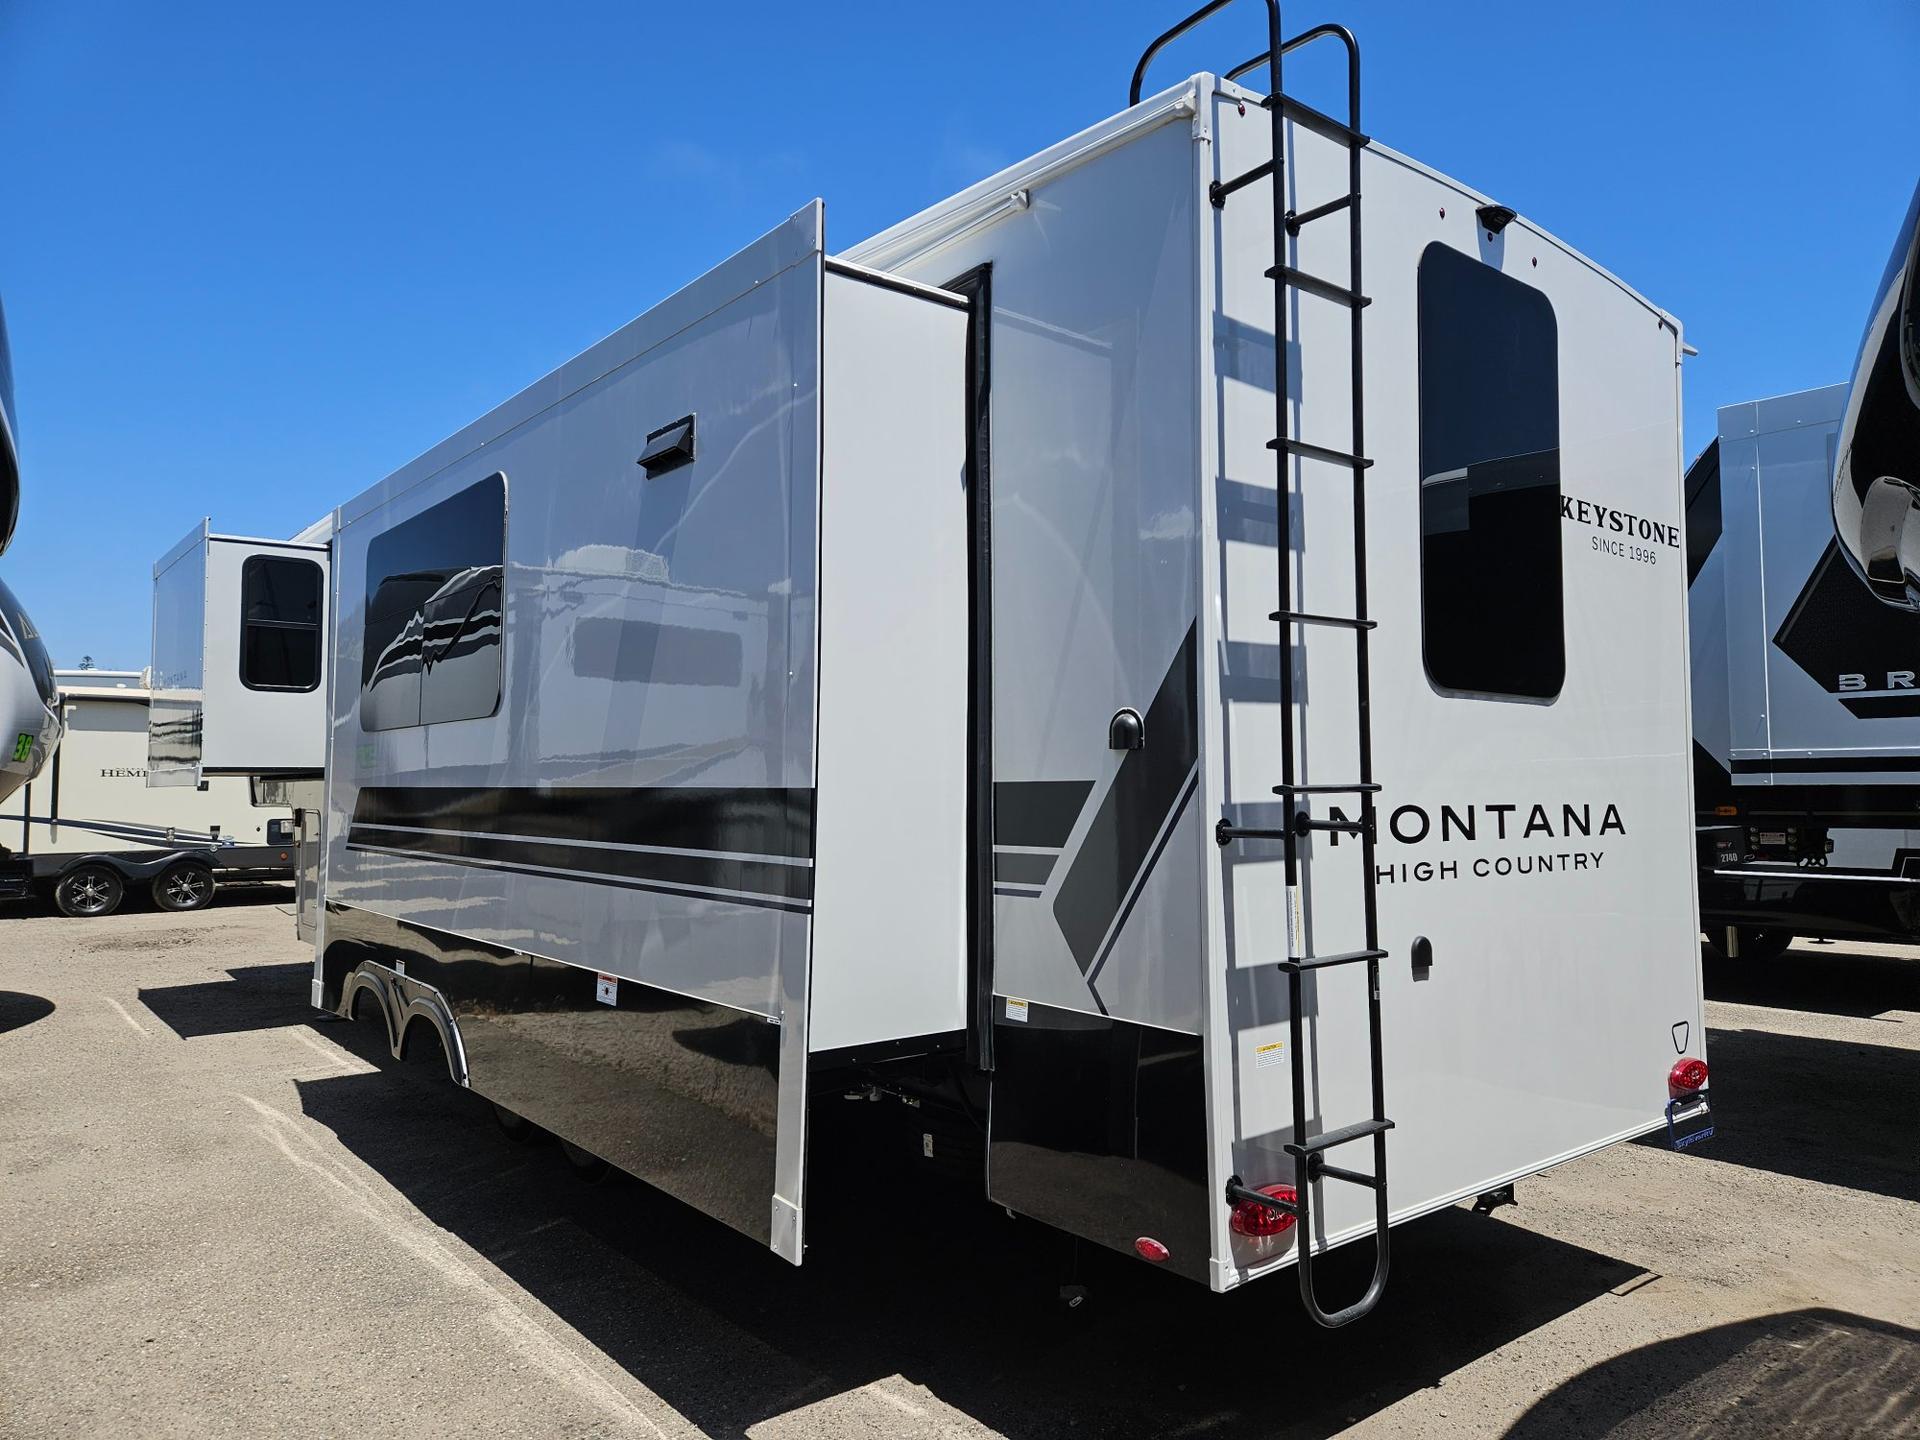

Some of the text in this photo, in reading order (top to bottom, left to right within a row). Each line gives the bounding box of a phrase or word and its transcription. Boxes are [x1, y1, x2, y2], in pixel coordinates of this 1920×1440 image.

[1560, 494, 1680, 549] KEYSTONE
[1591, 536, 1657, 565] SINCE 1996
[1329, 803, 1627, 847] MONTANA
[1375, 851, 1604, 885] HIGH COUNTRY
